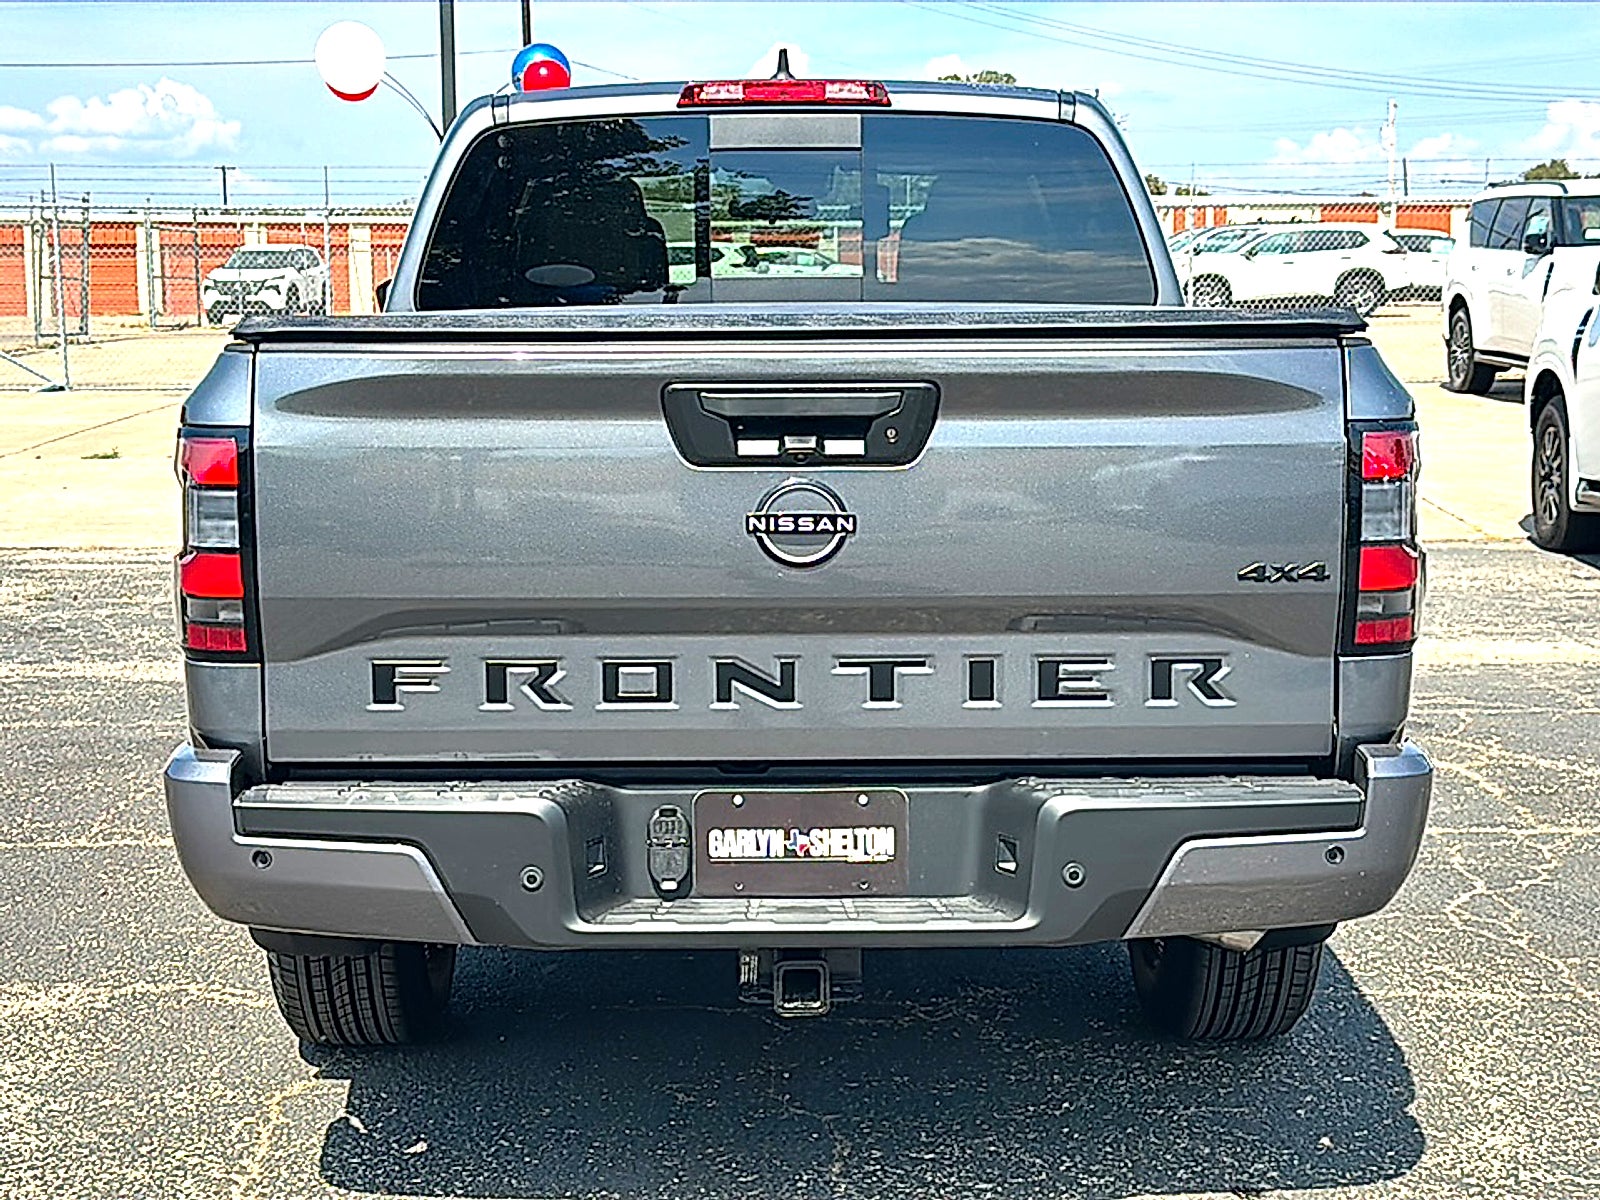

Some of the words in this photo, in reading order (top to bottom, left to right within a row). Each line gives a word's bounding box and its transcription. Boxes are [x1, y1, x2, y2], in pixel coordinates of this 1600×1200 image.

[748, 516, 854, 532] NISSAN
[367, 656, 1237, 710] FRONTIER
[708, 828, 785, 858] GARLYN
[809, 827, 895, 857] SHELTON
